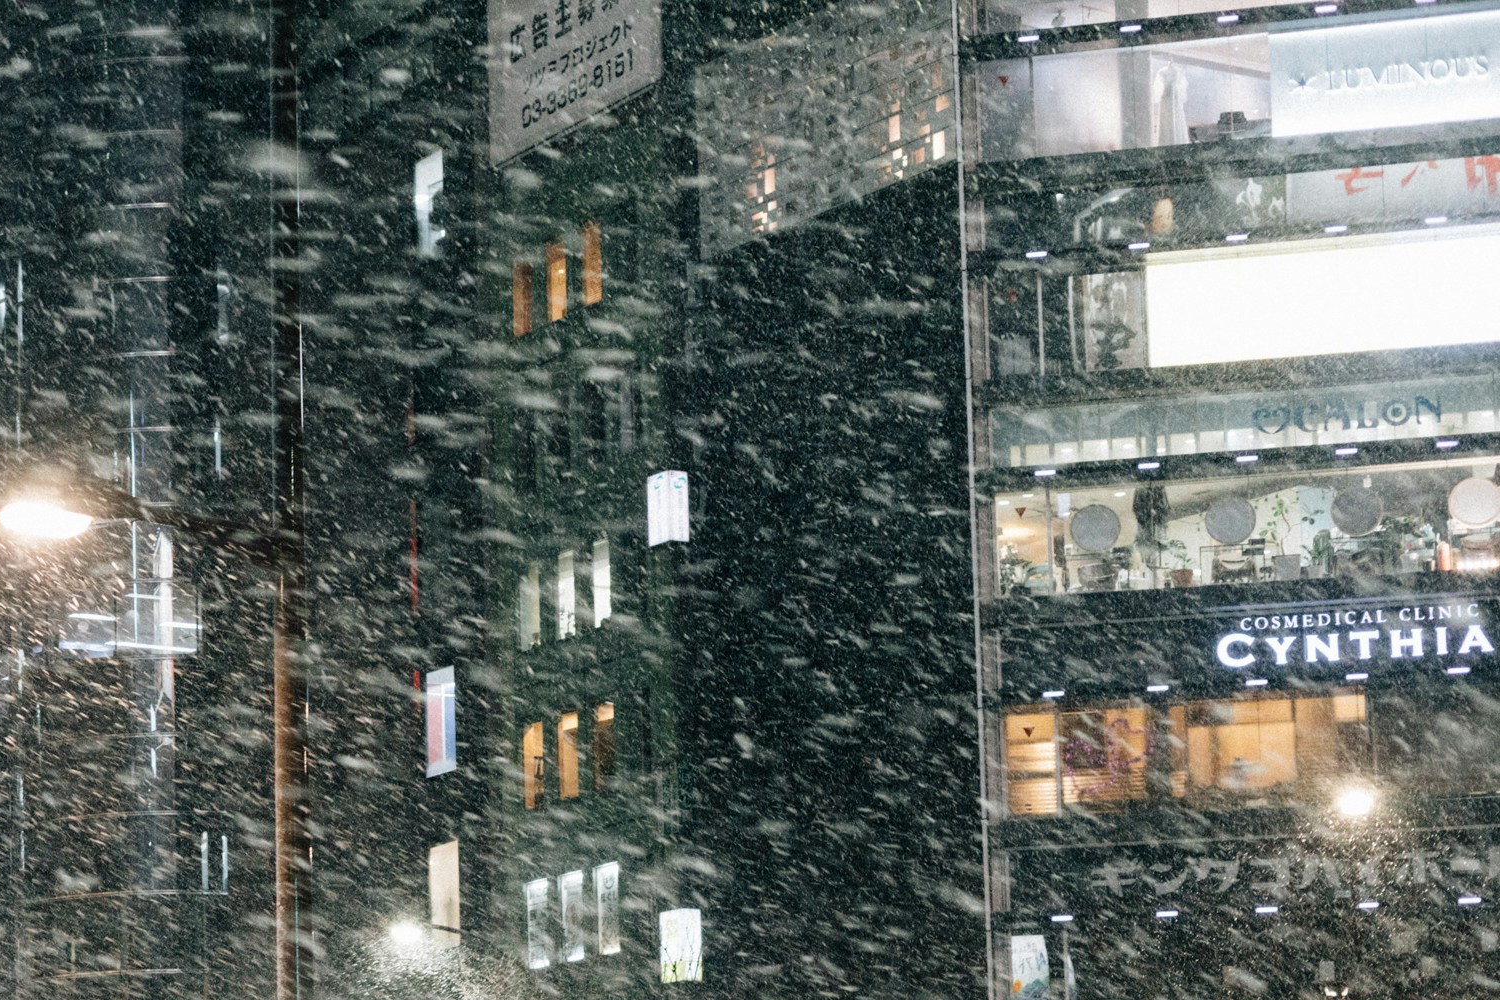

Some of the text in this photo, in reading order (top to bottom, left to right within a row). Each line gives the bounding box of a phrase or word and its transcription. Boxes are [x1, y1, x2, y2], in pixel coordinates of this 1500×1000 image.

[1325, 55, 1489, 92] LUMINOUS
[1294, 395, 1442, 432] CALON
[1240, 602, 1480, 631] COSMEDICAL CLINIC
[1216, 624, 1495, 668] CYNTHIA
